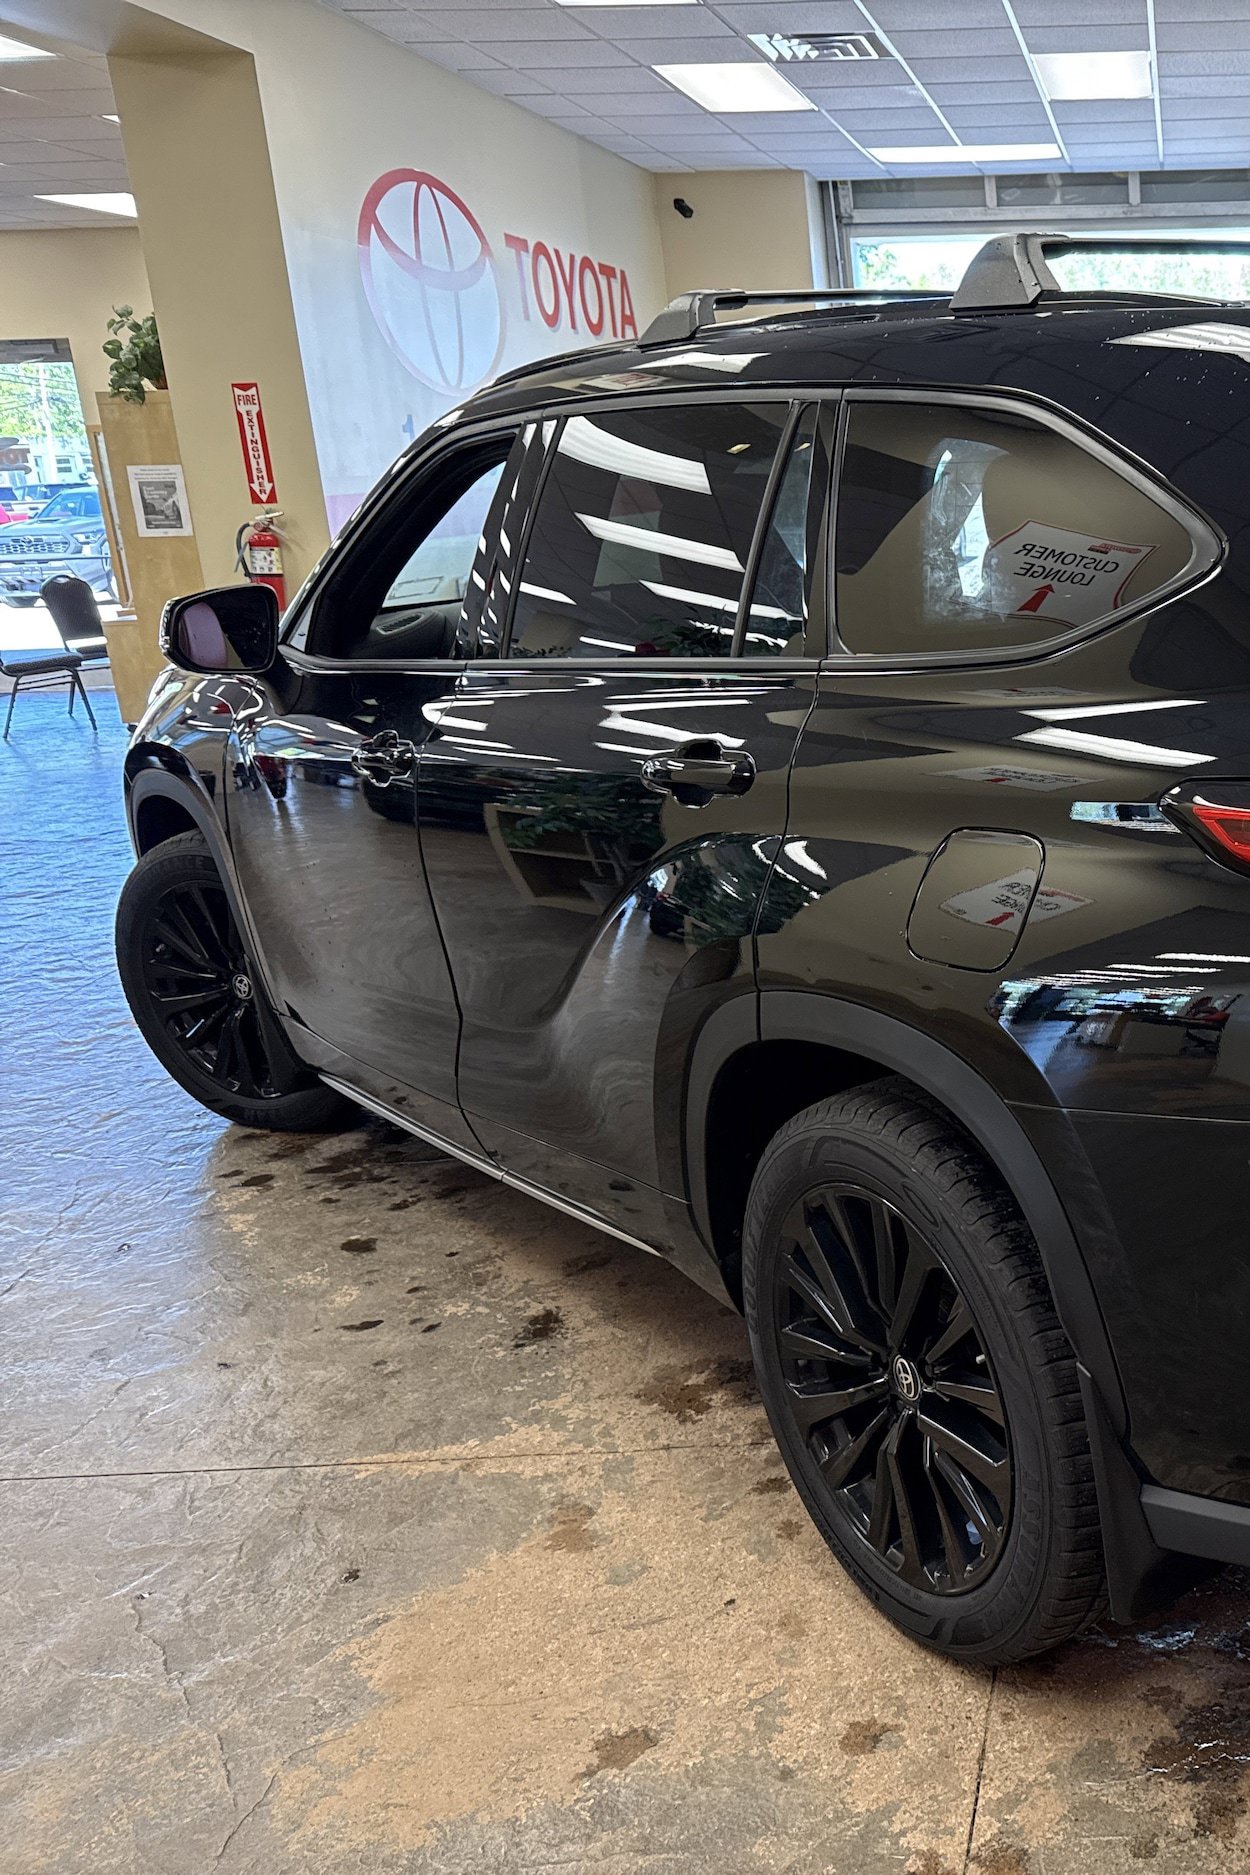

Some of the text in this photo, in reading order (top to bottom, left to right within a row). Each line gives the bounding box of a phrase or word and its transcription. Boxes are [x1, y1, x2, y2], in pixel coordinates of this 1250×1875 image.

[503, 232, 639, 339] TOYOTA
[237, 394, 258, 406] FIRE
[245, 410, 267, 496] EXTINGUISHER
